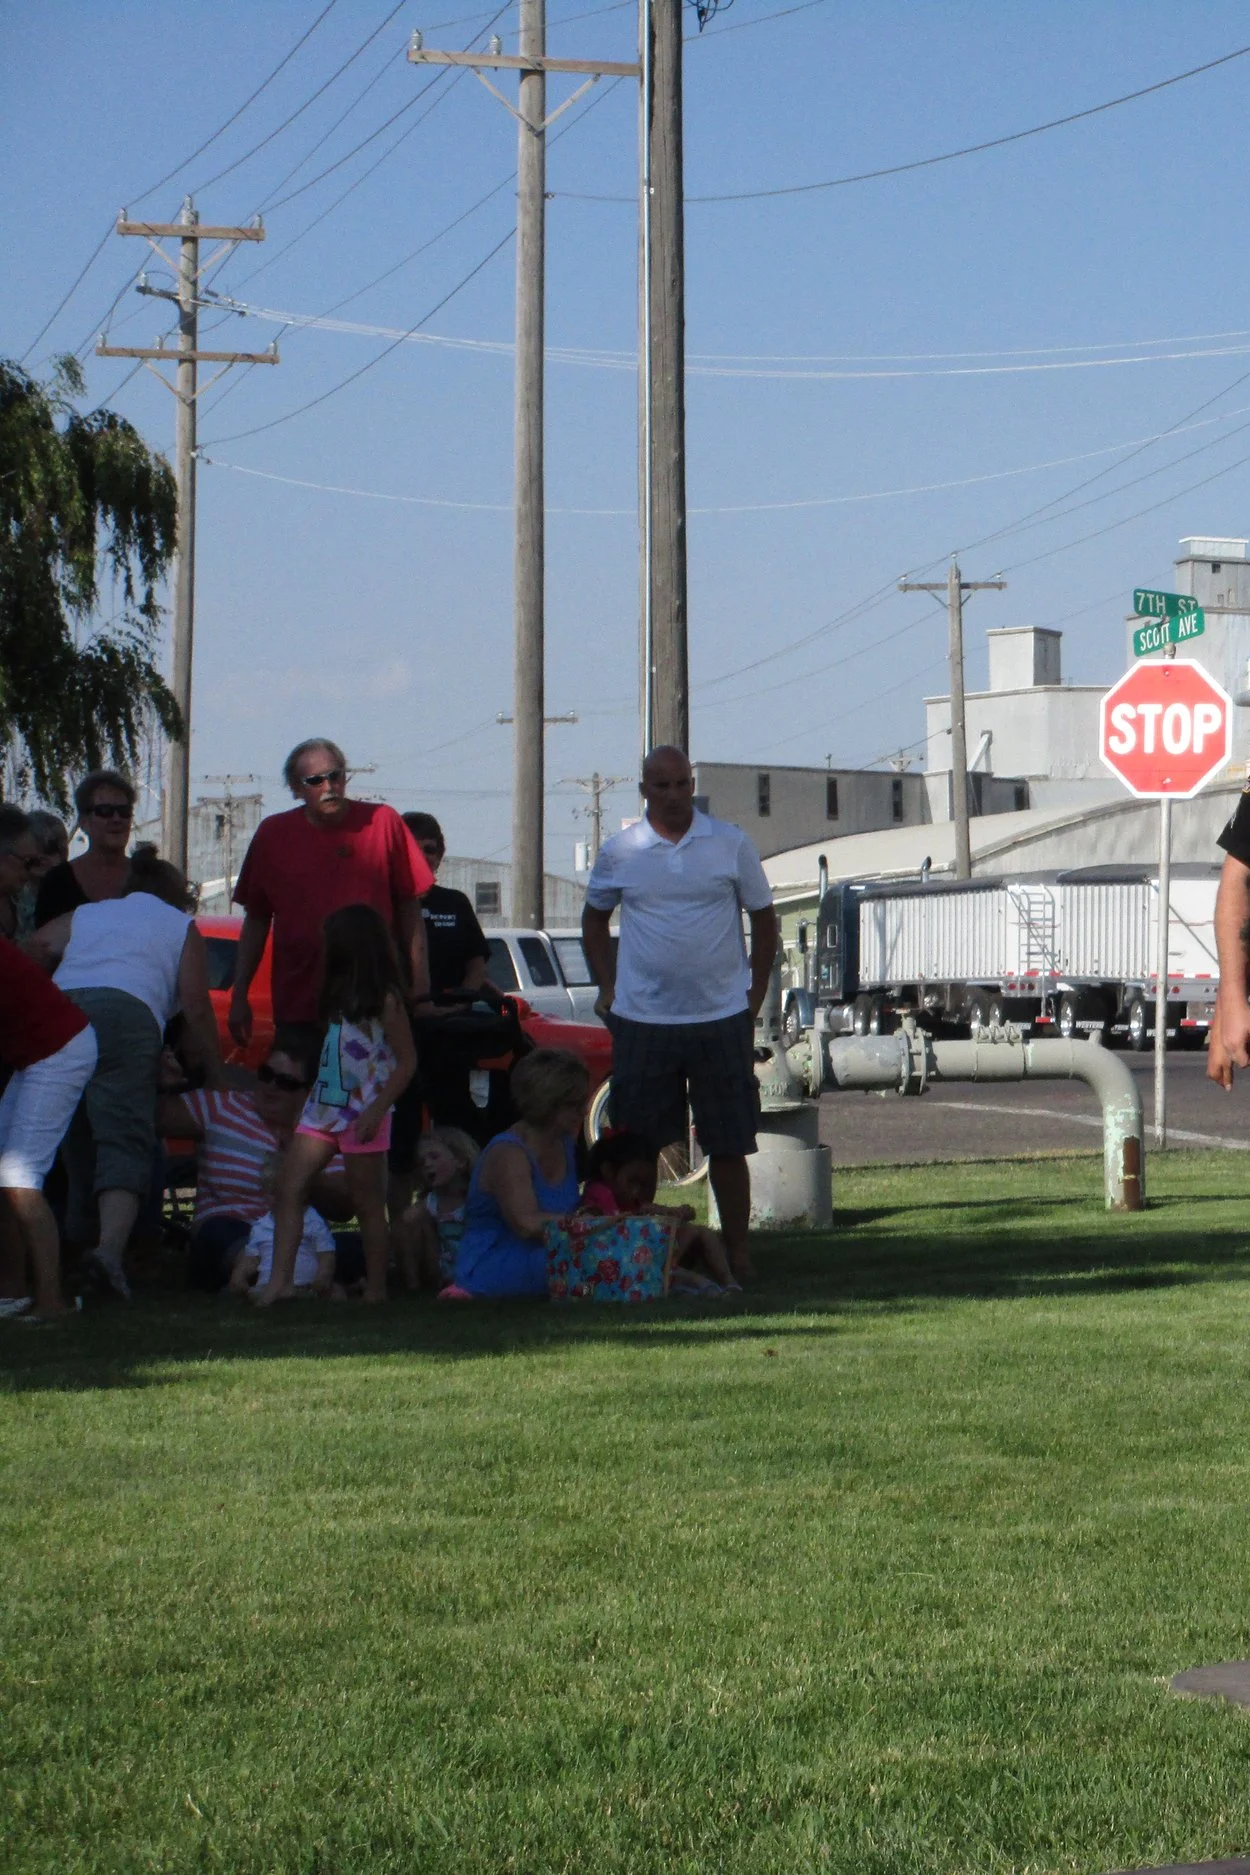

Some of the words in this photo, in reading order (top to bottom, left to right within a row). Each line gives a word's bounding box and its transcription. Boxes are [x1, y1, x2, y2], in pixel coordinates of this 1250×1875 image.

[1136, 592, 1166, 615] 7TH
[1178, 598, 1196, 615] ST
[1140, 622, 1170, 651] SCOTT
[1178, 613, 1198, 638] AVE
[1108, 702, 1222, 755] STOP
